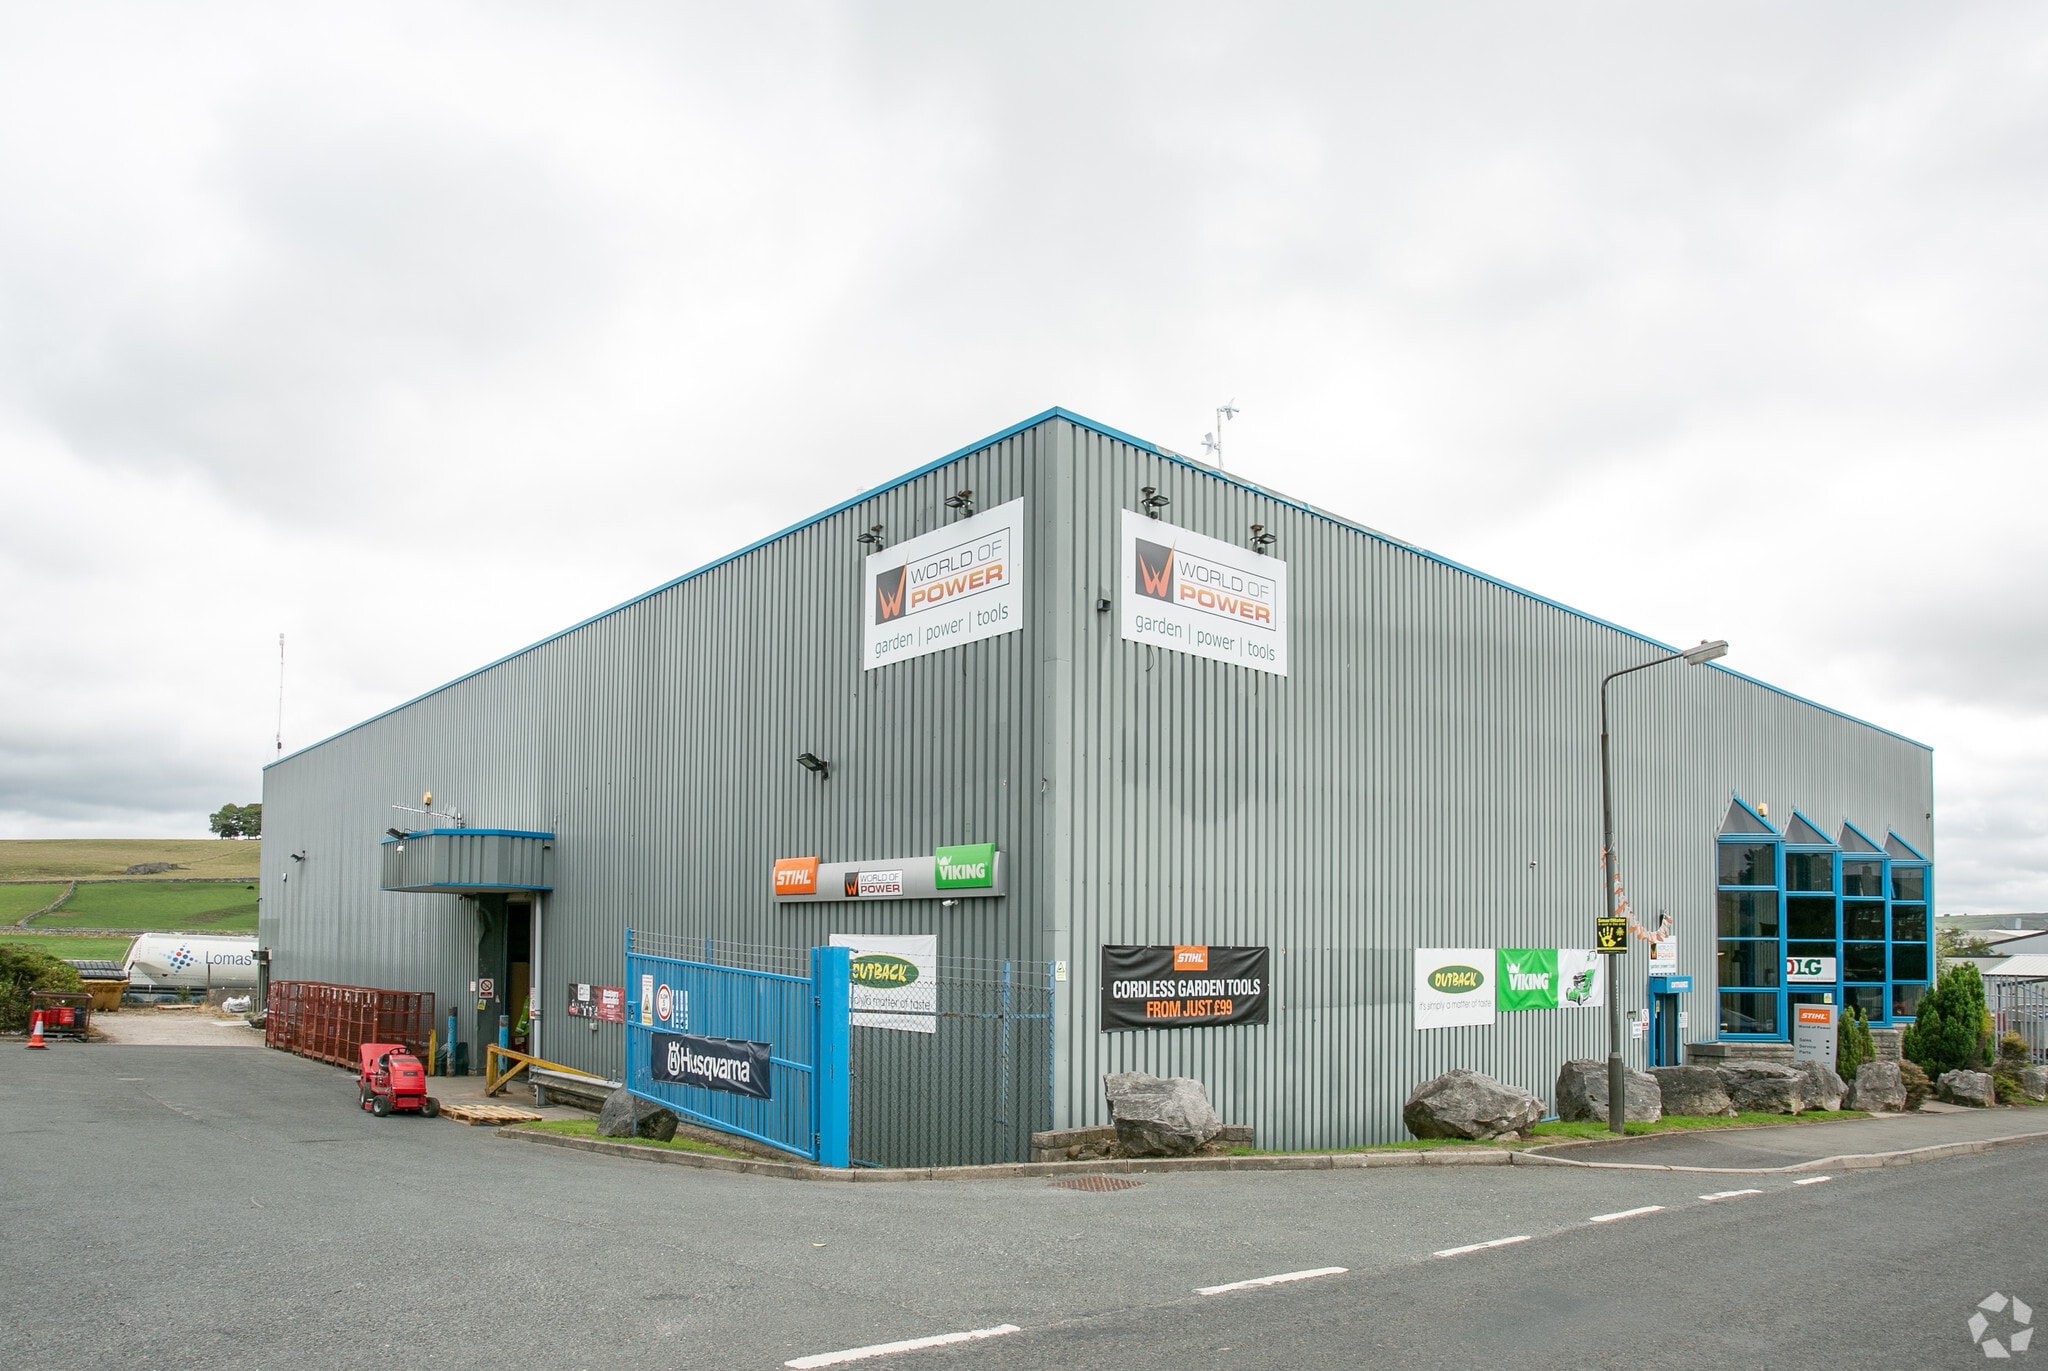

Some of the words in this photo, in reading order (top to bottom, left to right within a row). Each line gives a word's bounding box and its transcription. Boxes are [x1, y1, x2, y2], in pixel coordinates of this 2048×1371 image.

[911, 551, 972, 584] WORLD
[978, 539, 1002, 562] OF
[911, 564, 1003, 608] POWER
[1179, 560, 1243, 592] WORLD
[1248, 581, 1269, 599] OF
[1180, 583, 1270, 624] POWER
[875, 632, 913, 658] garden
[926, 618, 963, 644] power
[977, 603, 1009, 626] tools
[1135, 615, 1182, 638] garden
[1197, 630, 1234, 650] power
[1248, 640, 1275, 661] tools
[776, 869, 811, 886] STIHL
[860, 873, 886, 883] WORLD
[888, 872, 899, 882] OF
[939, 863, 985, 881] VIKING
[860, 884, 900, 894] POWER
[206, 951, 252, 966] Lomas
[1177, 953, 1204, 963] STIHL
[852, 963, 907, 983] OUTBACK
[1434, 972, 1477, 987] OUTBACK
[1509, 973, 1549, 990] VIKING
[1113, 980, 1175, 999] CORDLESS
[1178, 979, 1225, 997] GARDEN
[1226, 978, 1261, 996] TOOLS
[873, 997, 898, 1008] matter
[899, 998, 908, 1007] of
[910, 999, 931, 1010] taste
[1146, 1000, 1181, 1018] FROM
[1183, 1000, 1212, 1017] JUST
[1214, 999, 1233, 1016] £99
[1427, 1001, 1445, 1011] simply
[1452, 1000, 1471, 1009] matter
[1478, 999, 1491, 1008] taste
[680, 1047, 750, 1083] Husqvarna
